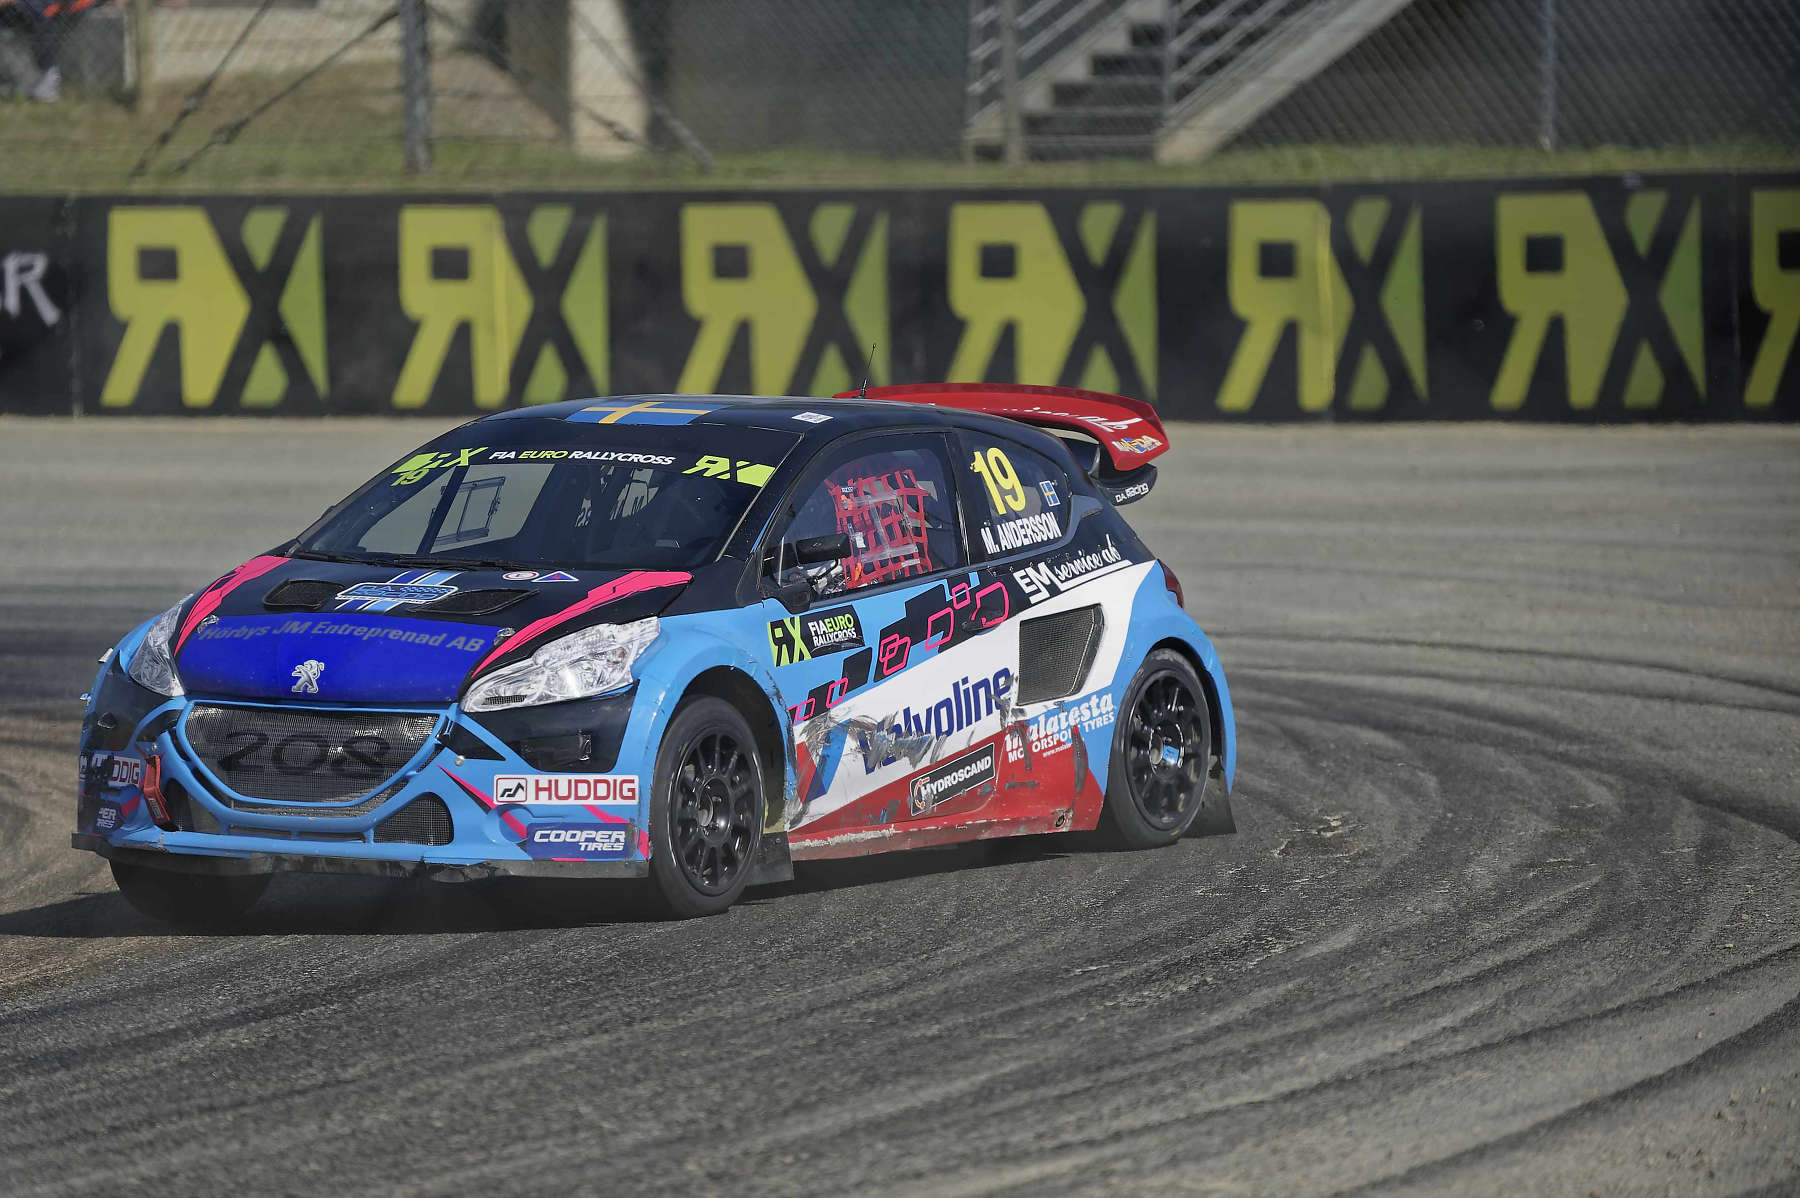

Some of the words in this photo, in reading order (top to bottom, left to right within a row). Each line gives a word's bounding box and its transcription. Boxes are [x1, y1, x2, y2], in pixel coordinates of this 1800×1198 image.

[0, 251, 60, 326] R
[489, 451, 516, 459] FIA
[518, 451, 568, 459] EURO
[568, 451, 676, 465] RALLYCROSS
[970, 447, 1026, 515] 19
[981, 526, 1000, 554] M.
[998, 512, 1062, 550] ANDERSSON
[1054, 549, 1103, 581] service
[272, 620, 312, 634] JM
[311, 621, 446, 647] Entreprenad
[446, 636, 486, 652] AB
[812, 627, 857, 647] RALLYCROSS
[1083, 711, 1115, 733] TYRES
[217, 731, 392, 780] 208
[535, 779, 636, 801] HUDDIG
[920, 755, 992, 799] HYDROSCAND
[534, 830, 625, 843] COOPER
[578, 842, 624, 851] TIRES
